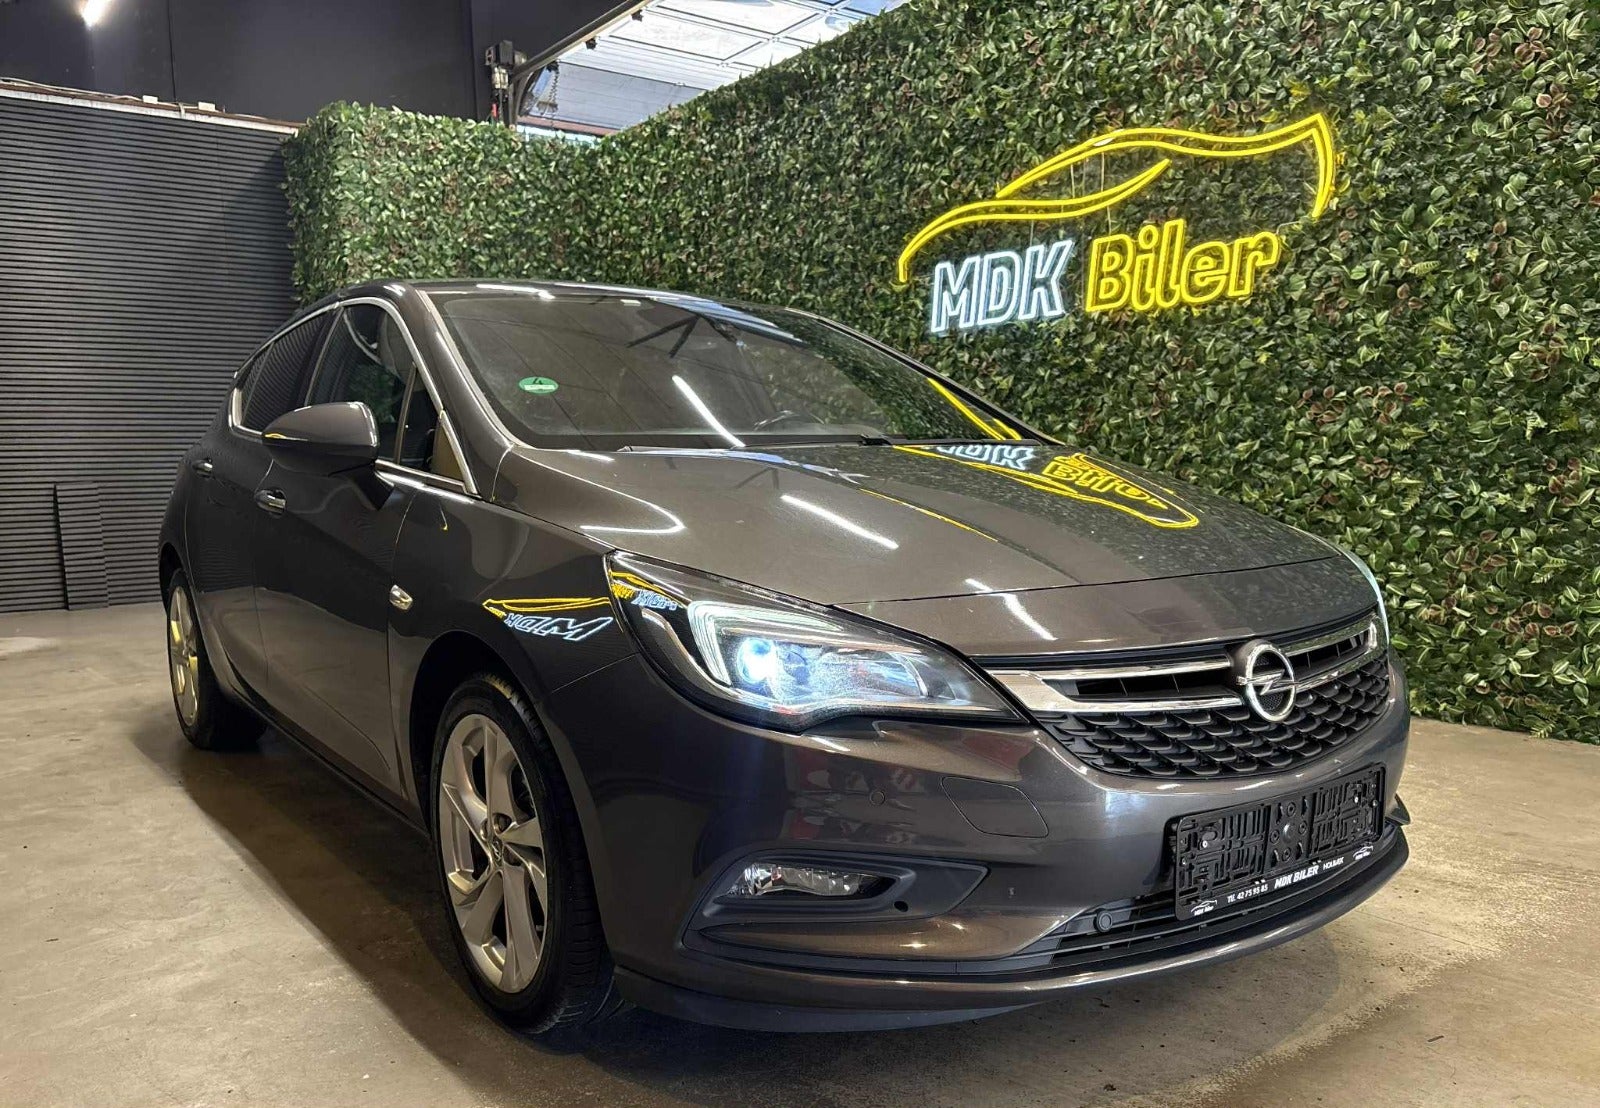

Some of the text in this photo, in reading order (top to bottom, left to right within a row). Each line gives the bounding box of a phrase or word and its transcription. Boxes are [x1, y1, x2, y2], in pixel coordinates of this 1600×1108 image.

[930, 218, 1283, 334] MDK Biler
[1237, 891, 1245, 900] 42
[1245, 889, 1253, 898] 75
[1274, 874, 1293, 889] MDK
[1293, 864, 1319, 883] BILER
